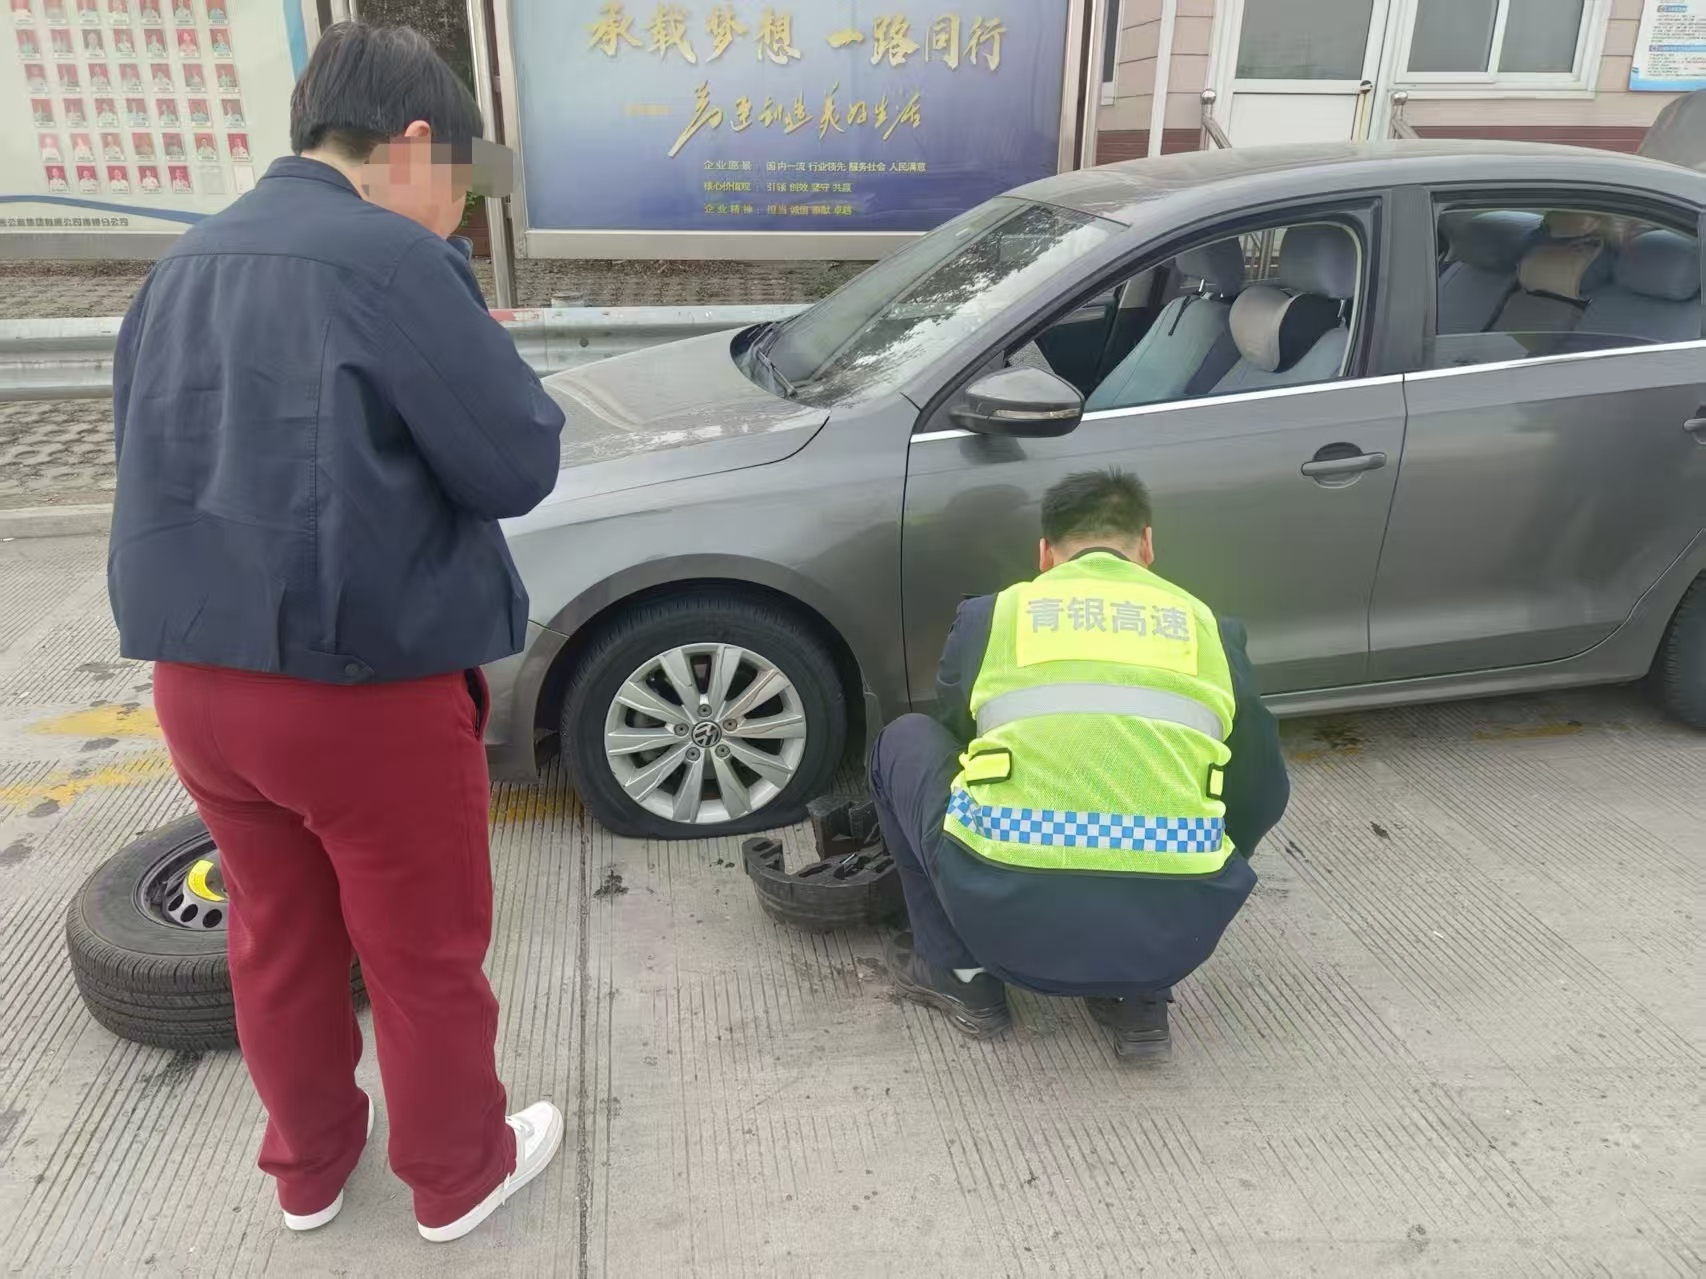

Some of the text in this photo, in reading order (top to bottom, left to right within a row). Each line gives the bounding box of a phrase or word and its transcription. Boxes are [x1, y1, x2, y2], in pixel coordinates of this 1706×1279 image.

[584, 2, 1007, 70] 承载梦想 一路同行
[767, 162, 805, 171] 国内一流
[808, 162, 847, 172] 行业领先
[850, 162, 886, 172] 服务社会
[889, 162, 927, 172] 人民满意
[1027, 597, 1190, 641] 青银高速
